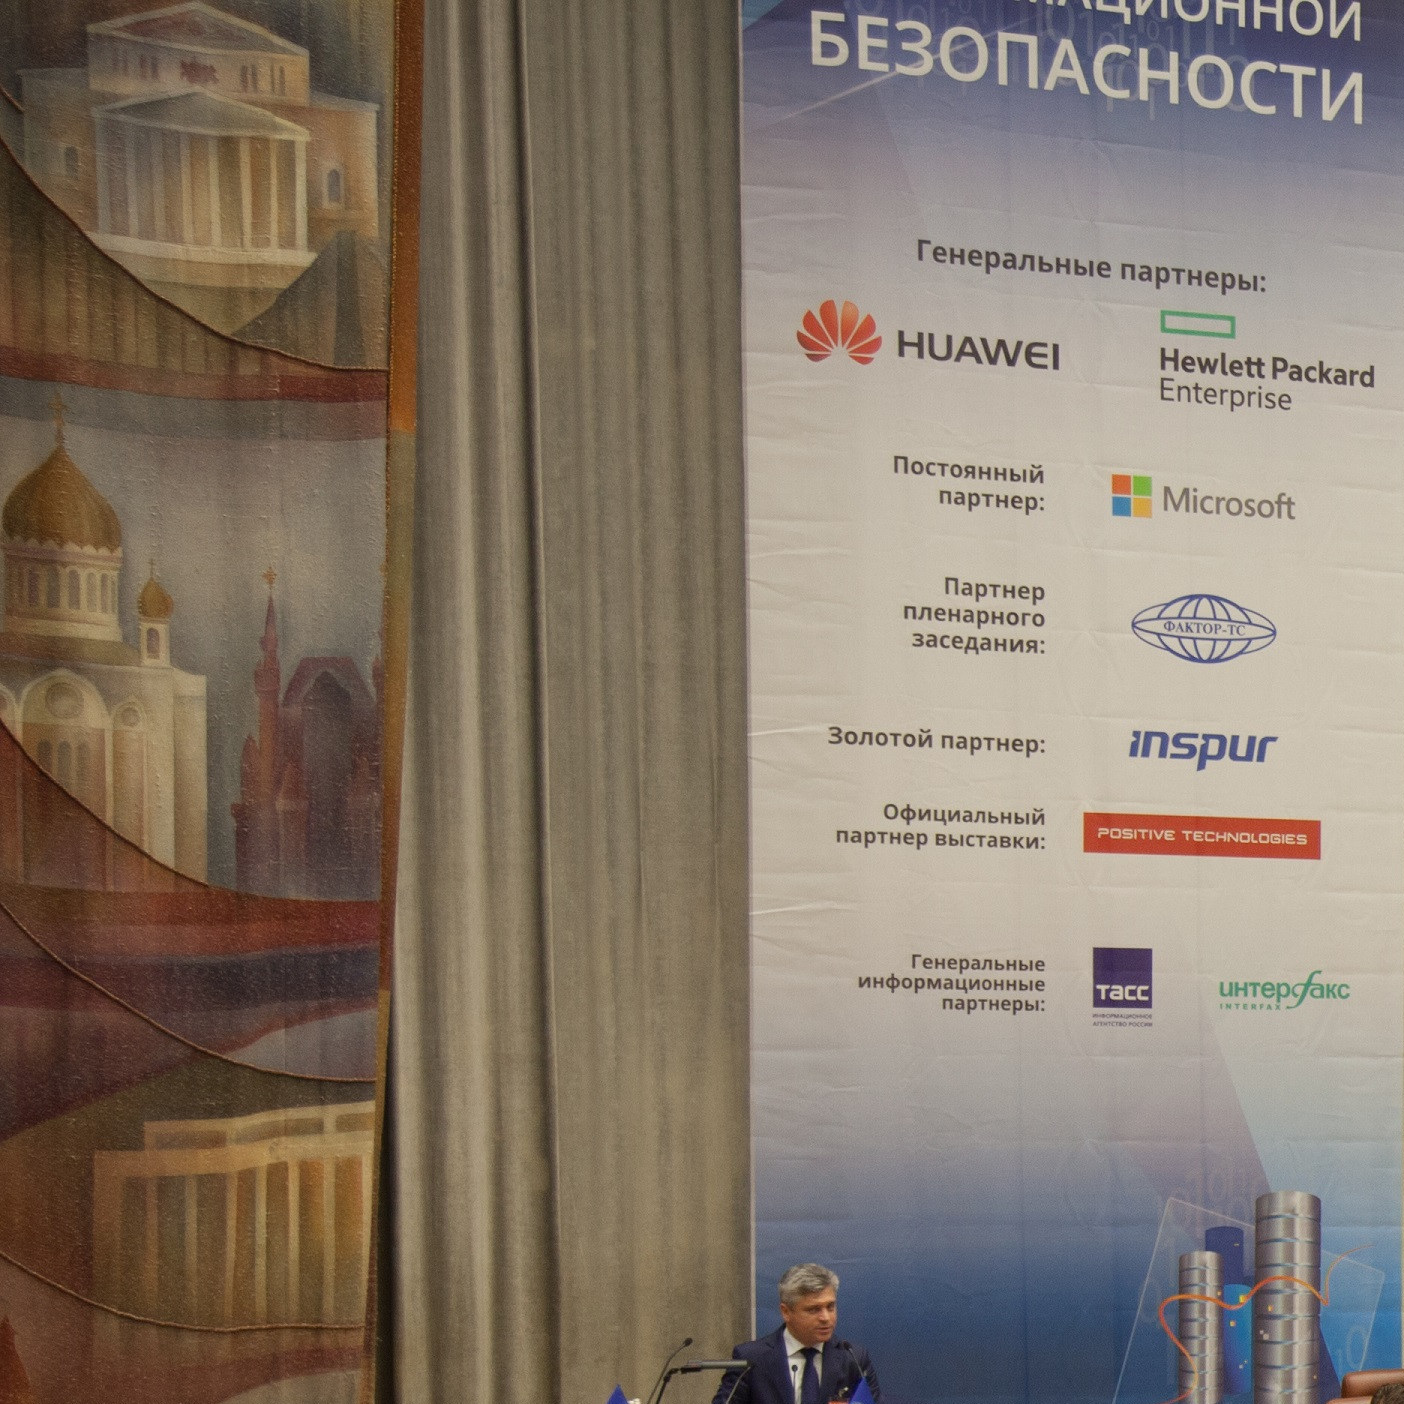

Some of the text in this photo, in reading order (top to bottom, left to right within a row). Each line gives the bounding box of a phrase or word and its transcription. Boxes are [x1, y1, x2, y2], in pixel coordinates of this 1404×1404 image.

[809, 10, 1363, 125] БЕЗОПАСНОСТИ
[916, 237, 1267, 295] Генеральные партнеры:
[897, 329, 1060, 371] HUAWEI
[1159, 346, 1376, 389] Hewlett Packard
[1159, 376, 1292, 412] Enterprise
[893, 453, 1045, 486] Постоянный
[939, 487, 1045, 513] партнер:
[1162, 485, 1296, 521] Microsoft
[943, 576, 1046, 606] Партнер
[903, 602, 1046, 630] пленарного
[1162, 618, 1246, 638] ФАКТОР-ТС
[912, 630, 1046, 656] заседания:
[827, 724, 1046, 756] Золотой партнер:
[1128, 729, 1279, 771] inspur
[882, 802, 1046, 828] Официальный
[835, 828, 1046, 851] партнер выставки:
[1097, 826, 1308, 846] POSITIVE TECHNOLOGIES
[910, 952, 1046, 974] Генеральные
[857, 973, 1046, 996] информационные
[1219, 970, 1351, 1010] интерфакс
[941, 995, 1046, 1013] партнеры:
